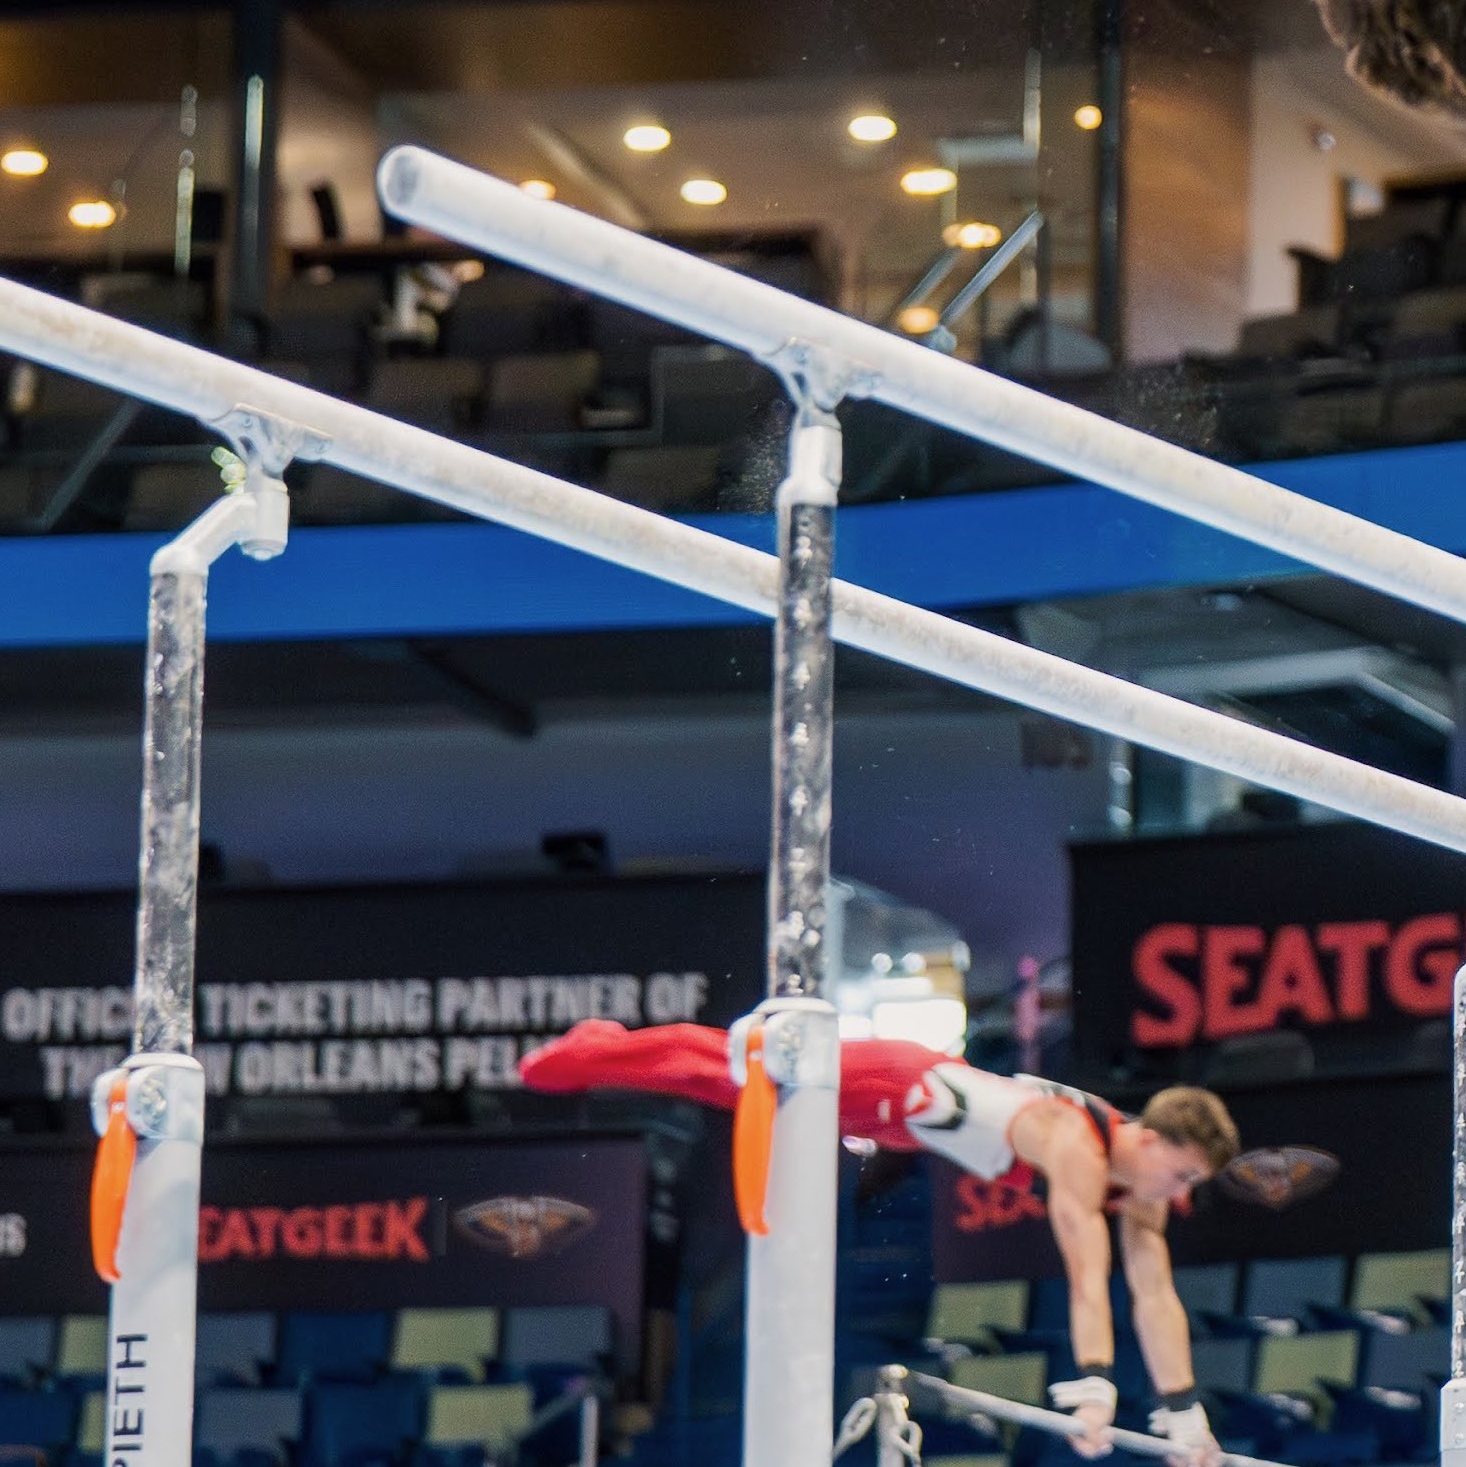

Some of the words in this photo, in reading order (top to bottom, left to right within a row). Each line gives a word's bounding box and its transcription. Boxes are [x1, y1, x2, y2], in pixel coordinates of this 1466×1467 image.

[2, 986, 137, 1042] OFFIC
[197, 978, 434, 1036] TICKETING
[436, 973, 642, 1034] PARTNER
[644, 971, 710, 1024] OF
[237, 1037, 443, 1096] ORLEANS
[197, 1197, 430, 1263] EATGEEK
[112, 1333, 148, 1467] IETH
